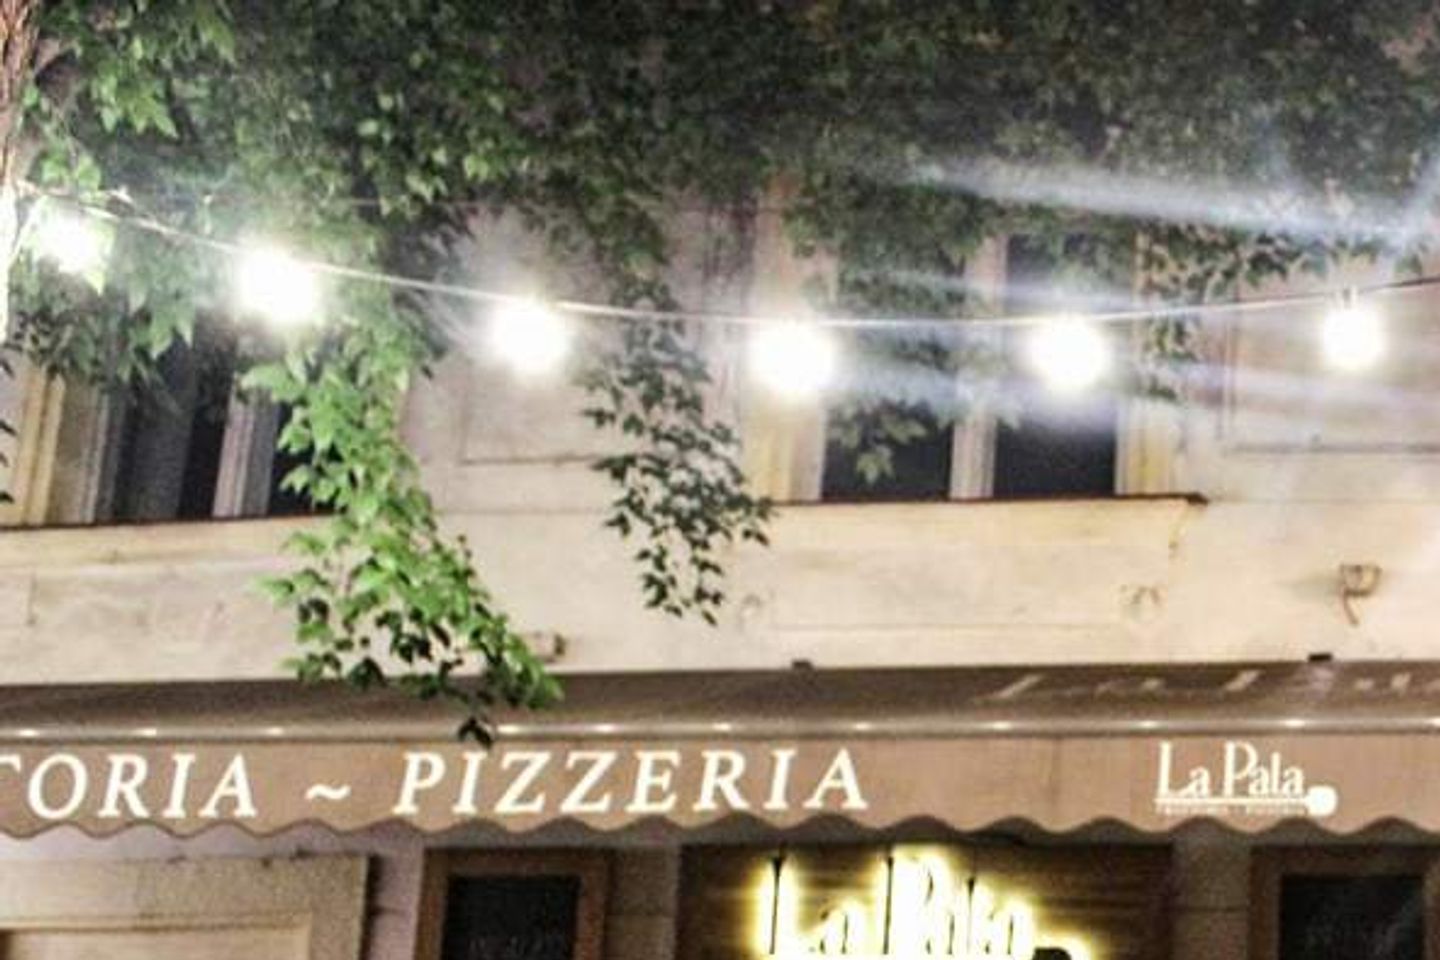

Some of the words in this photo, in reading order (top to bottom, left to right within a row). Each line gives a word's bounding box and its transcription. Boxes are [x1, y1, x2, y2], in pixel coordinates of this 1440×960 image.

[394, 746, 869, 818] PIZZERIA
[1156, 740, 1211, 799] La
[1223, 740, 1304, 798] Pala
